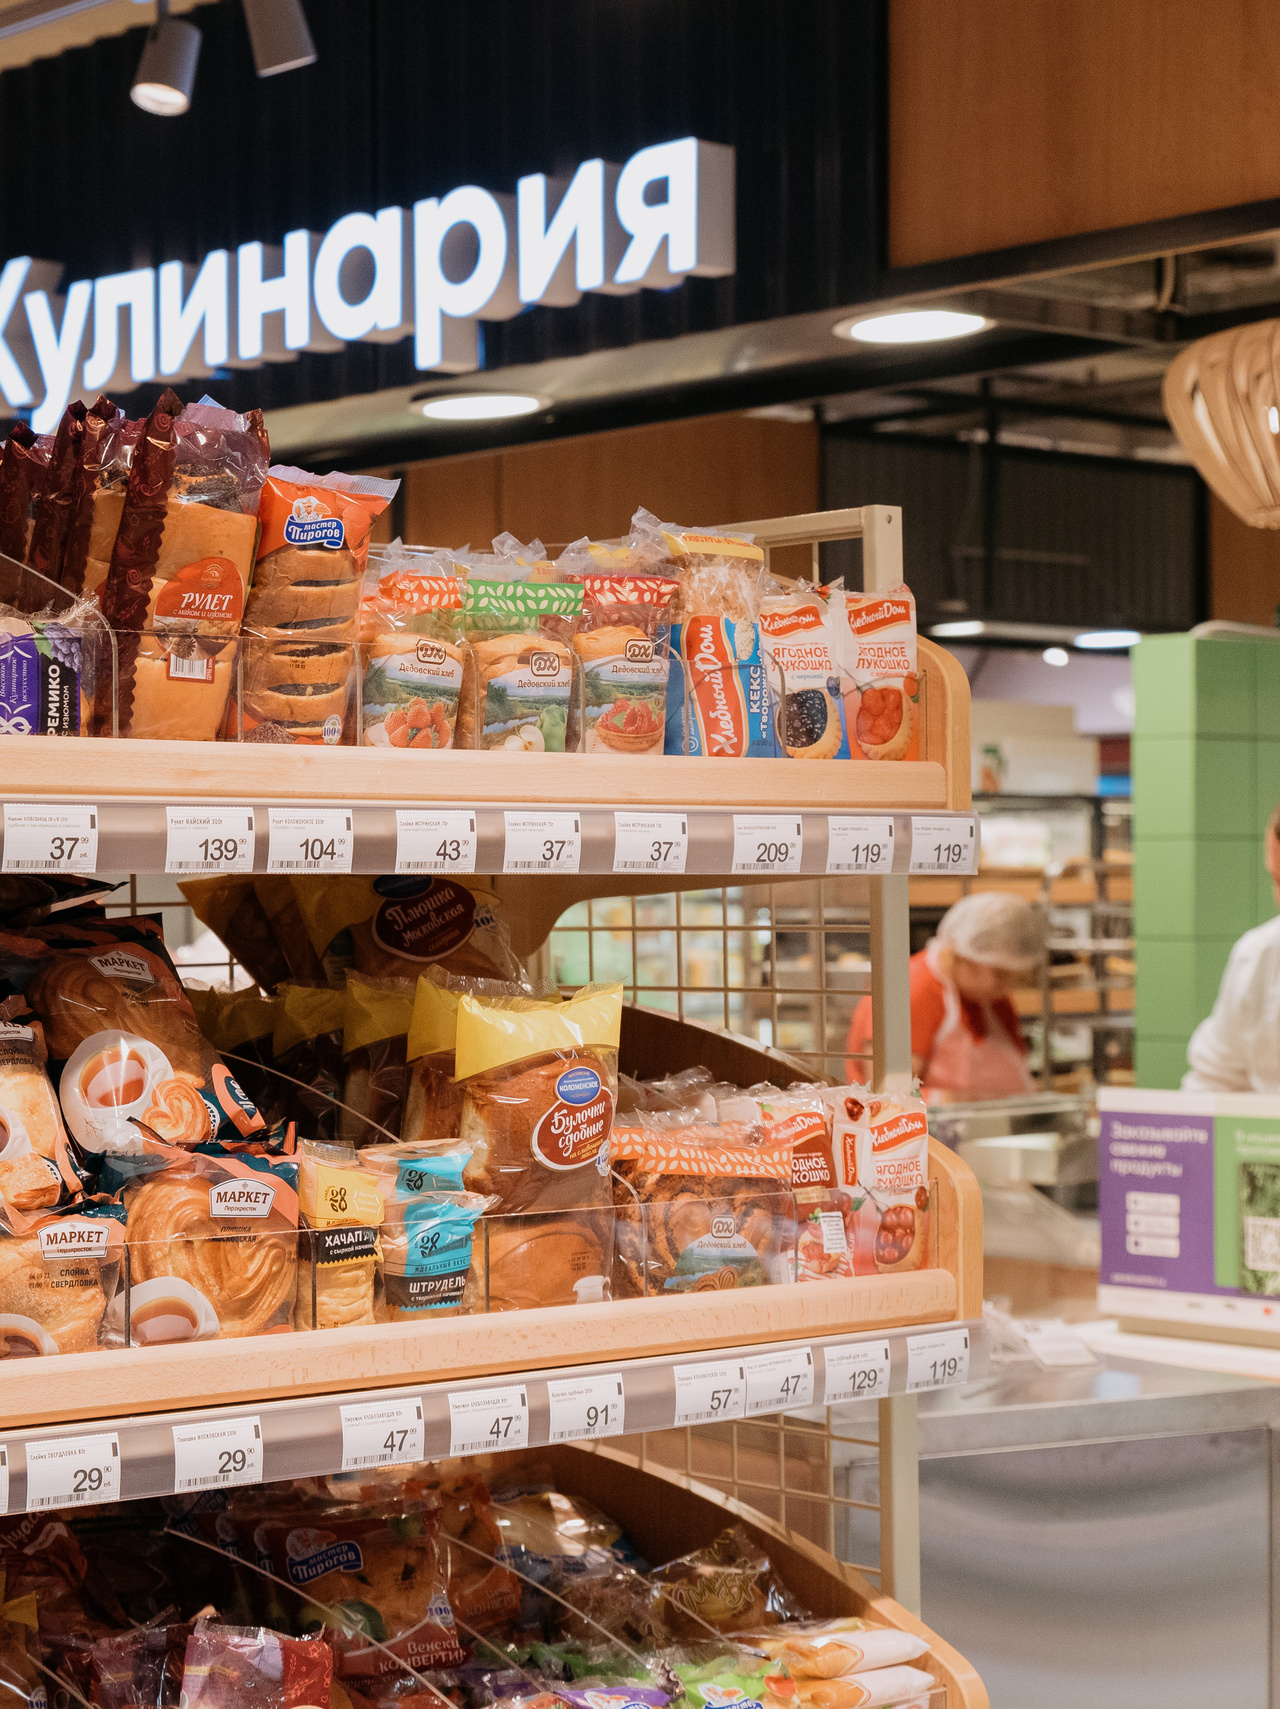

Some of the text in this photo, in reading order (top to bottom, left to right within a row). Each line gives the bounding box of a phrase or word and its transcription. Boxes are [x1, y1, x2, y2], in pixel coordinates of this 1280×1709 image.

[287, 524, 341, 541] Пирогов
[303, 519, 337, 531] мастер
[180, 592, 234, 611] РУЛЕТ
[694, 624, 722, 672] Дом
[772, 646, 830, 660] ЯГОДНОЕ
[857, 646, 908, 658] ЯГОДНОЕ
[399, 663, 456, 679] Дедовский хлеб
[611, 664, 650, 675] Дедовский
[855, 657, 911, 671] ЛУКОШКО
[517, 679, 555, 689] Дедовский
[749, 665, 762, 714] КЕКС
[49, 836, 80, 861] 37
[198, 838, 238, 861] 139
[299, 838, 336, 861] 104
[436, 839, 461, 861] 43
[542, 840, 566, 861] 37
[650, 841, 674, 862] 37
[756, 842, 789, 863] 209
[851, 843, 881, 863] 119
[933, 843, 962, 863] 119
[97, 956, 145, 972] МАРКЕТ
[559, 1081, 599, 1092] КОЛОМЕНСКОЕ
[550, 1101, 606, 1135] Булочки
[558, 1119, 604, 1157] сдобные
[876, 1160, 921, 1176] ЯГОДНОЕ
[215, 1190, 271, 1205] МАРКЕТ
[45, 1230, 104, 1246] МАРКЕТ
[696, 1239, 747, 1250] Дедовский хлеб
[59, 1268, 90, 1278] СЛОЙКА
[50, 1279, 99, 1290] СВЕРДЛОВКА
[409, 1276, 466, 1295] ШТРУДЕЛЬ
[929, 1357, 958, 1380] 119
[780, 1374, 801, 1396] 47
[848, 1369, 878, 1391] 129
[710, 1389, 733, 1411] 57
[586, 1404, 609, 1427] 91
[489, 1416, 513, 1439] 47
[383, 1429, 409, 1452] 47
[218, 1449, 246, 1474] 29
[73, 1467, 103, 1493] 29
[291, 1550, 358, 1581] Пирогов
